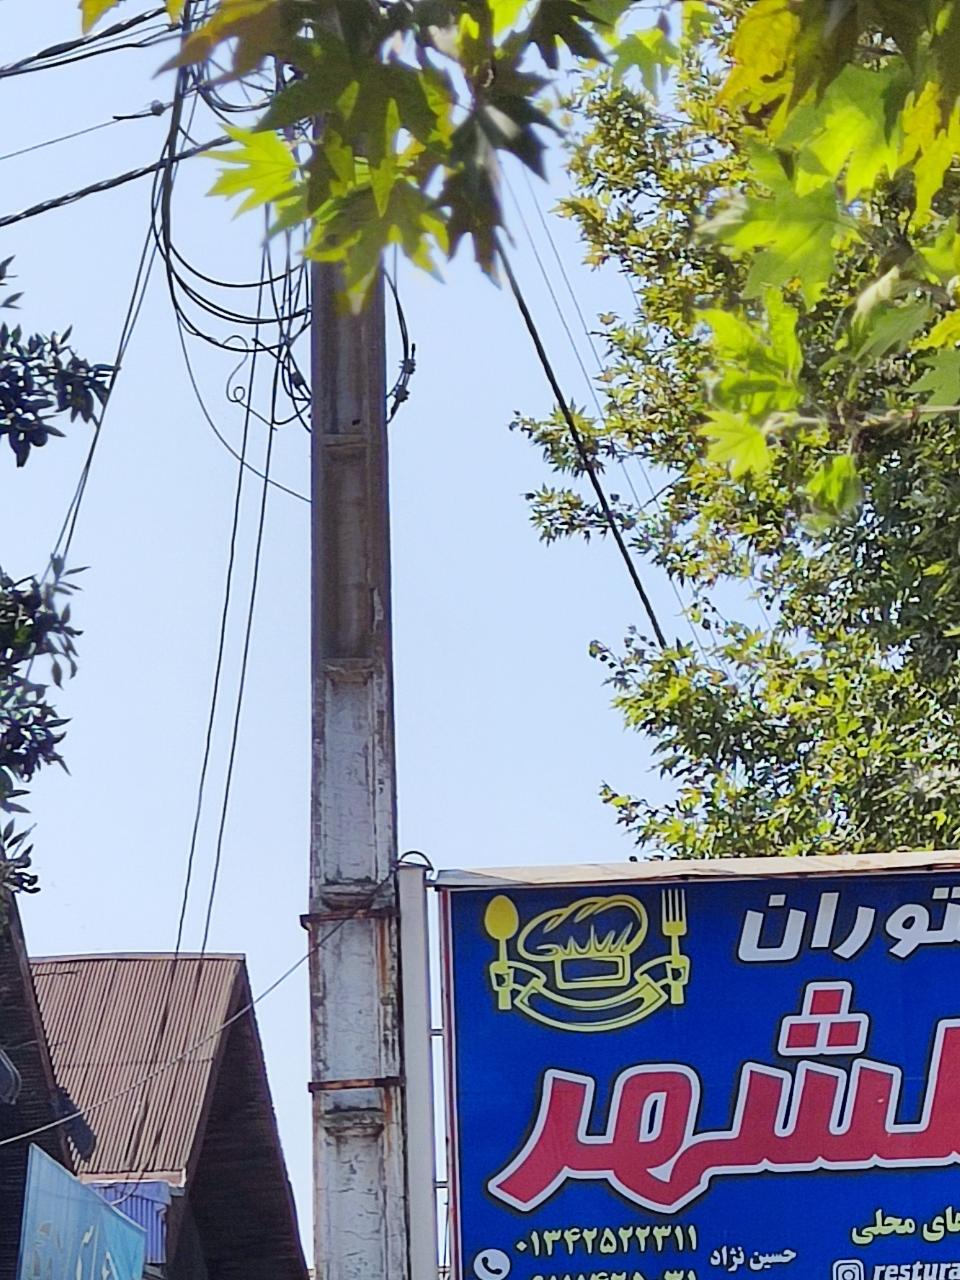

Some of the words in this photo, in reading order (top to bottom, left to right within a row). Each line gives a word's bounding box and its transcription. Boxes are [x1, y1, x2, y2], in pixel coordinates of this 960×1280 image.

[515, 1225, 698, 1256] ۰۱۳۴۲۵۲۲۳۱۱
[851, 1209, 916, 1245] محلی
[710, 1246, 745, 1272] نژاد
[749, 1249, 797, 1271] حسین
